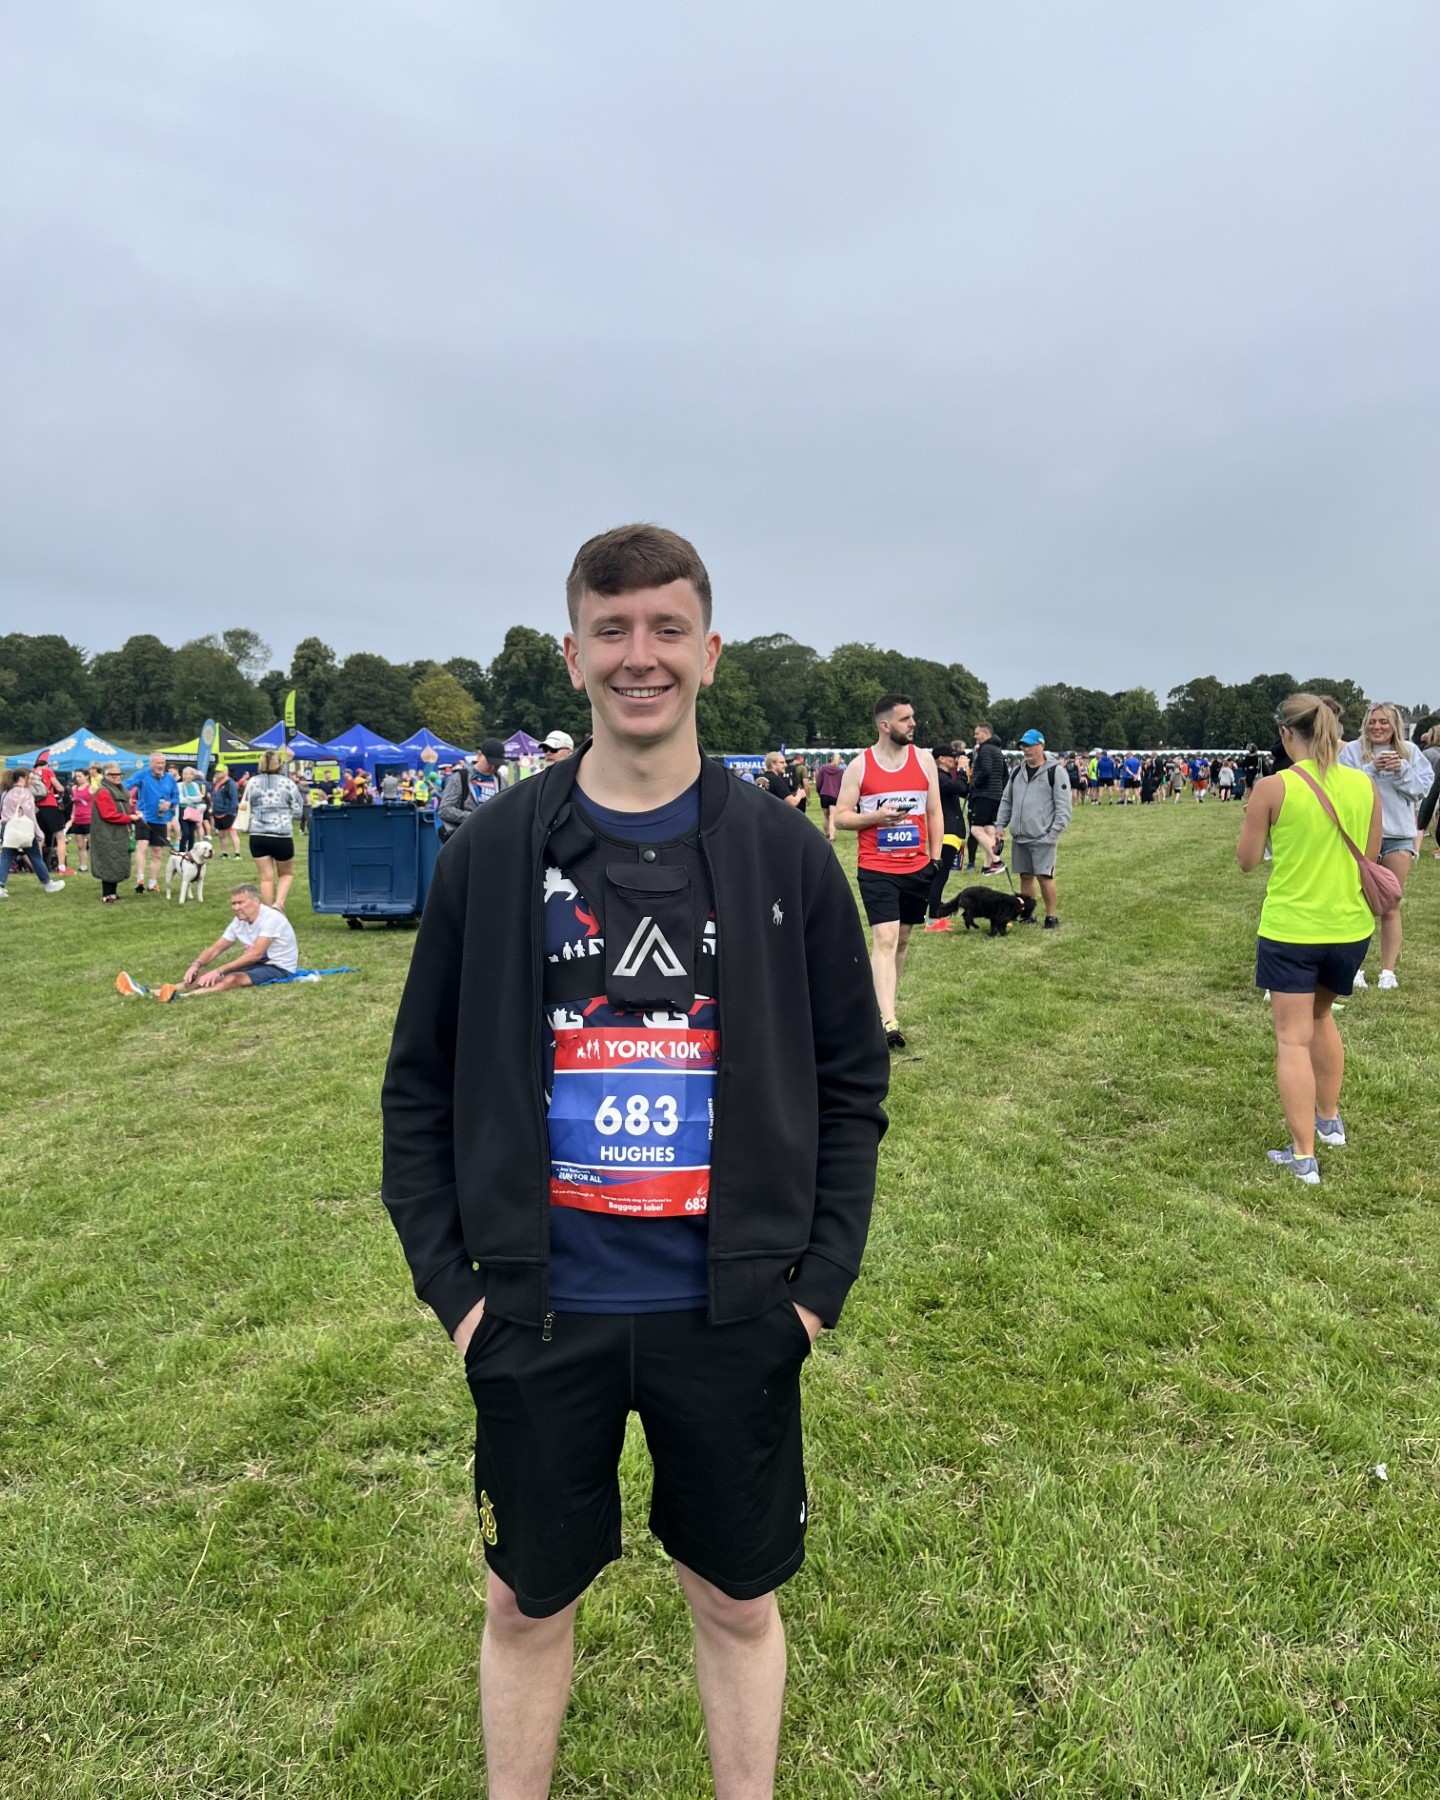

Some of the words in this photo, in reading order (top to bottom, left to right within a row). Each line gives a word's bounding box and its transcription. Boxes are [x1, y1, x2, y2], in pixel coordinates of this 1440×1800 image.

[887, 831, 912, 842] 5402
[605, 1040, 665, 1058] YORK
[669, 1041, 702, 1059] 10K
[594, 1094, 679, 1136] 683
[600, 1145, 675, 1162] HUGHES
[589, 1175, 602, 1183] ALL
[609, 1201, 641, 1212] Baggage
[644, 1203, 663, 1211] label
[685, 1197, 707, 1211] 683
